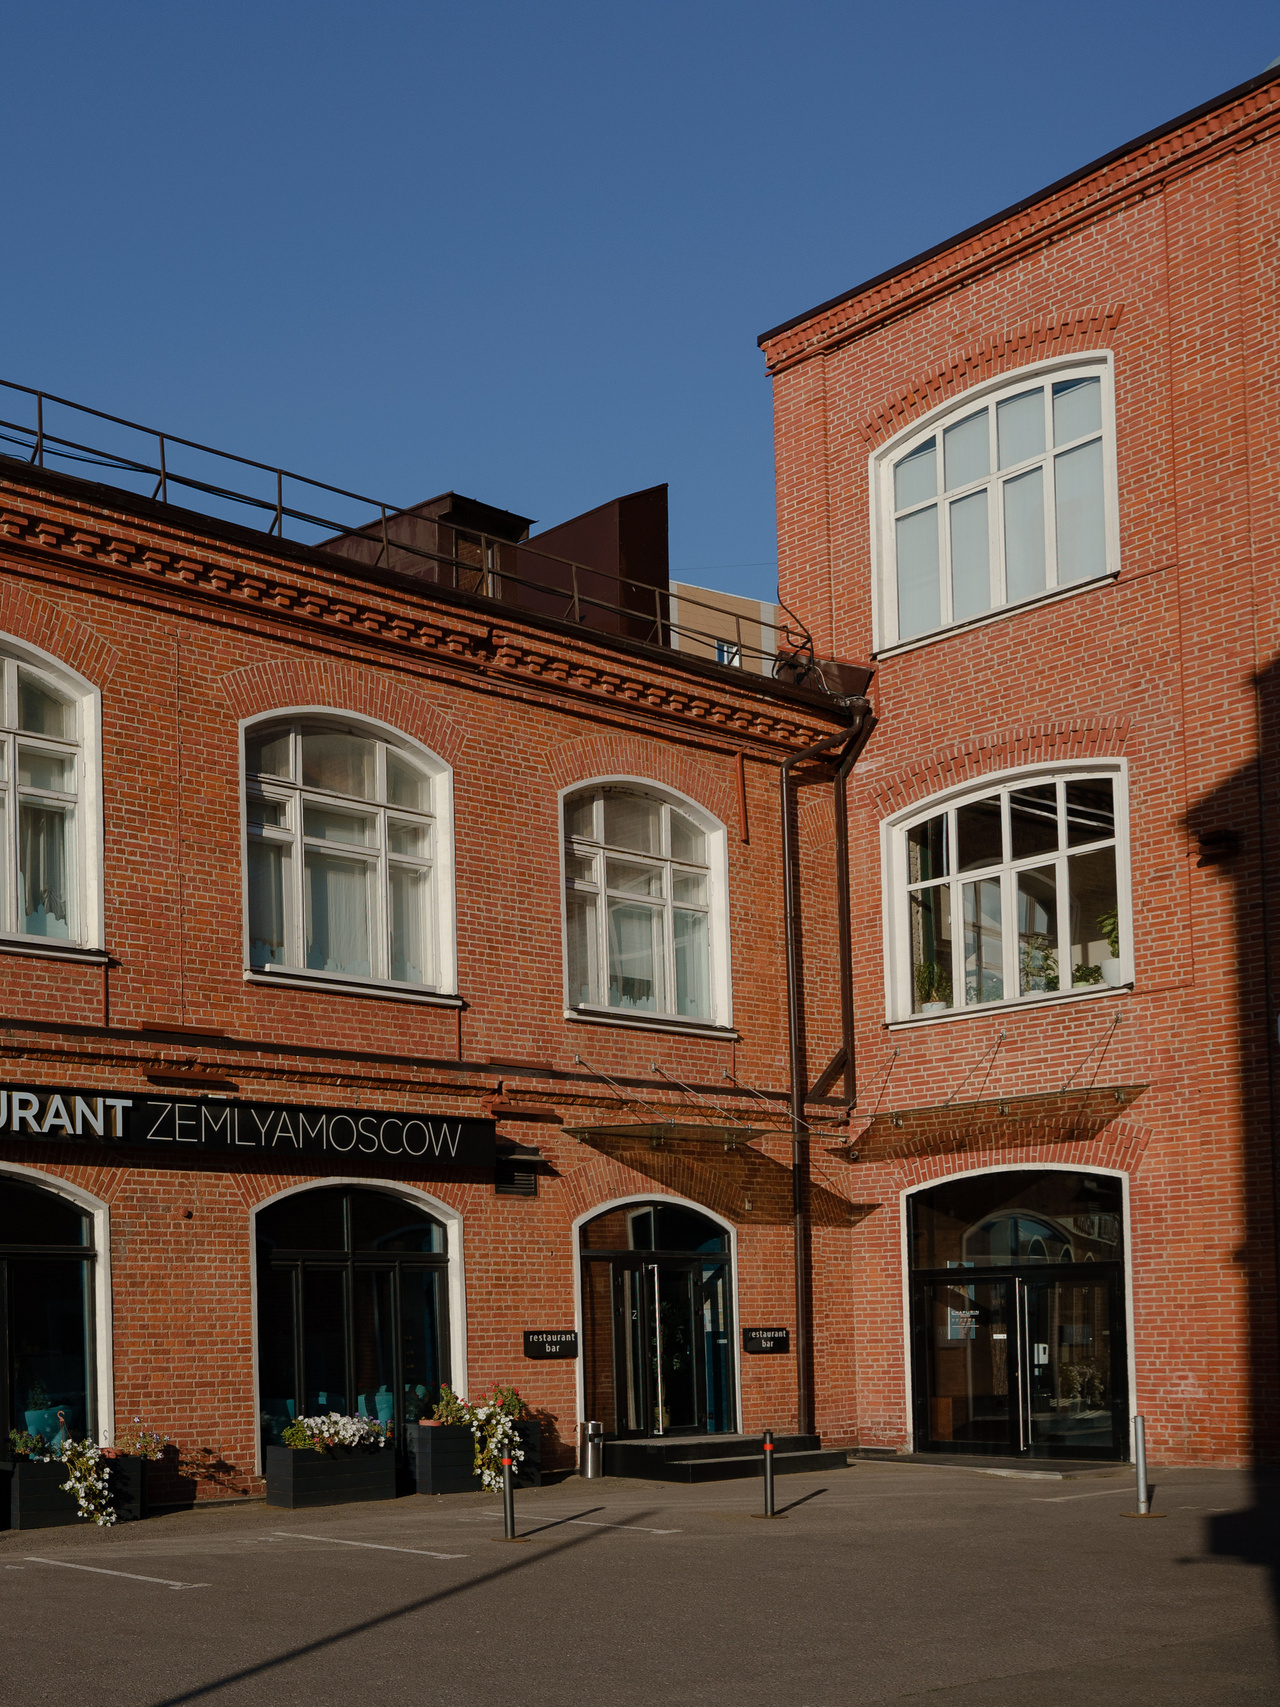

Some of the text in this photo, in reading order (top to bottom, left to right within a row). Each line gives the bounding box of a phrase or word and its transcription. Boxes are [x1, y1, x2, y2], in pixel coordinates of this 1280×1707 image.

[146, 1101, 463, 1159] ZEMLYAMOSCOW
[529, 1333, 576, 1342] restaurant
[748, 1330, 787, 1338] restaurant
[545, 1343, 560, 1353] bar
[761, 1339, 774, 1348] bar
